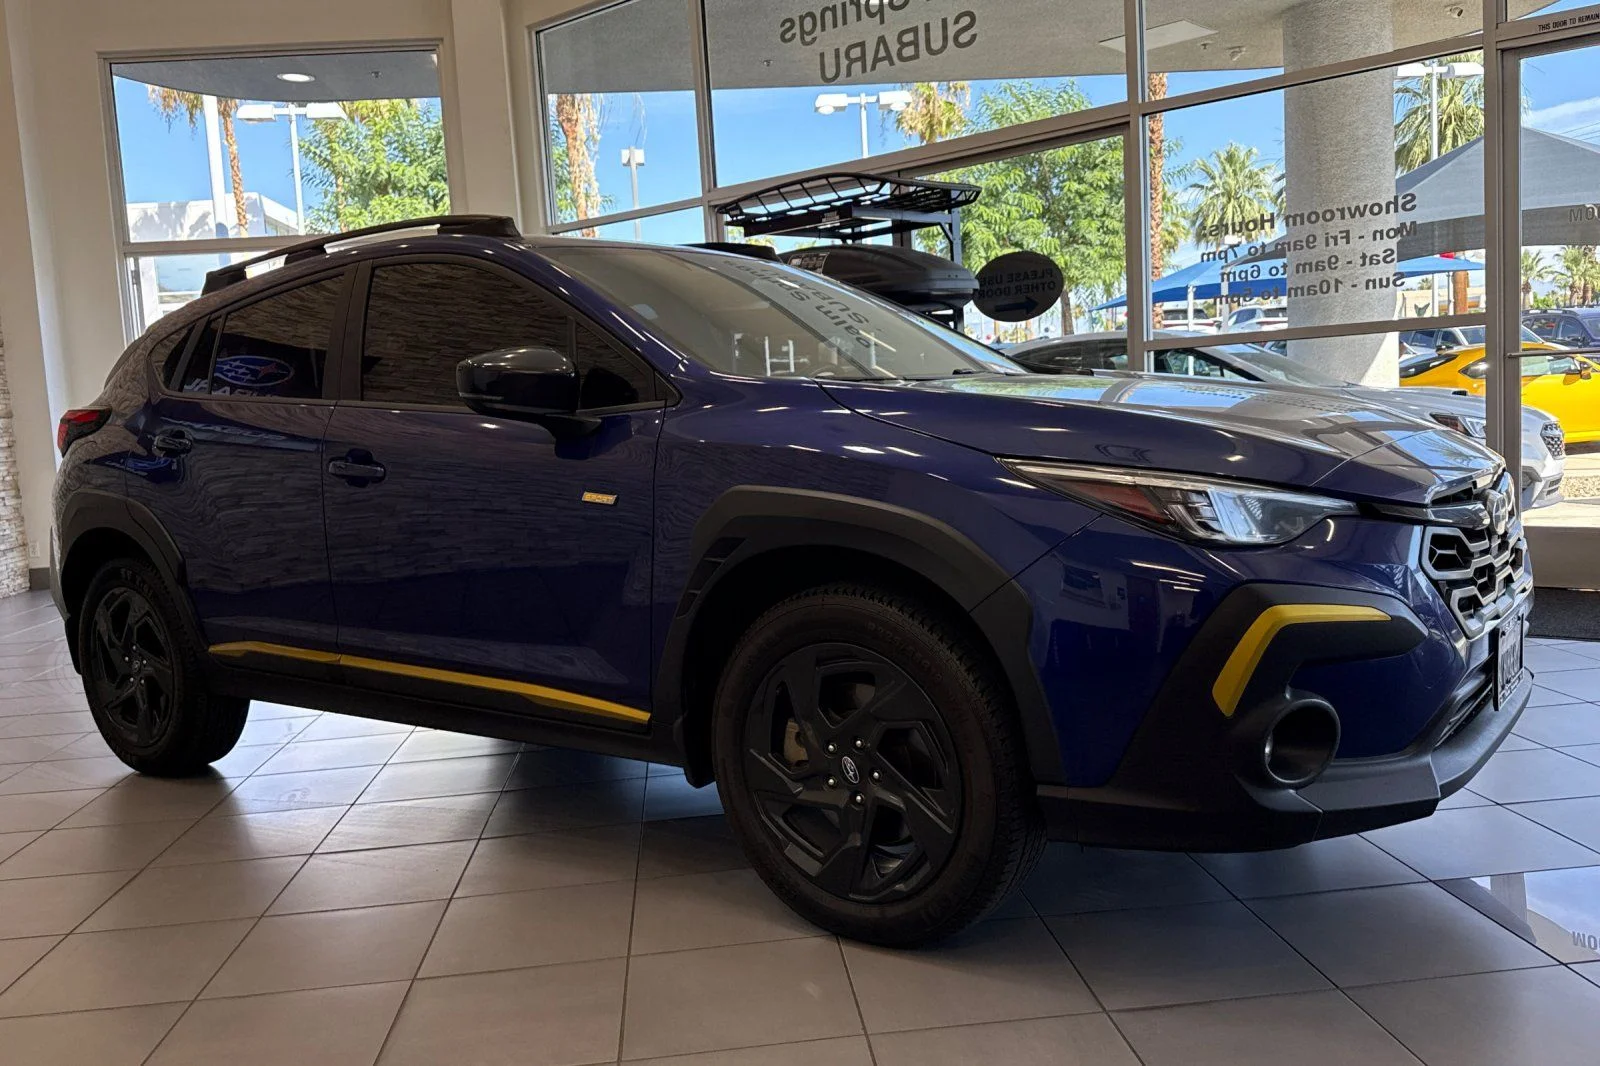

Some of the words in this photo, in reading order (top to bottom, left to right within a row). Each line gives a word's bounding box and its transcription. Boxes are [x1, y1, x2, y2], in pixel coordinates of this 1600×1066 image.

[1538, 23, 1551, 32] THIS
[1552, 20, 1567, 29] DOOR
[1577, 13, 1600, 23] REMAIN
